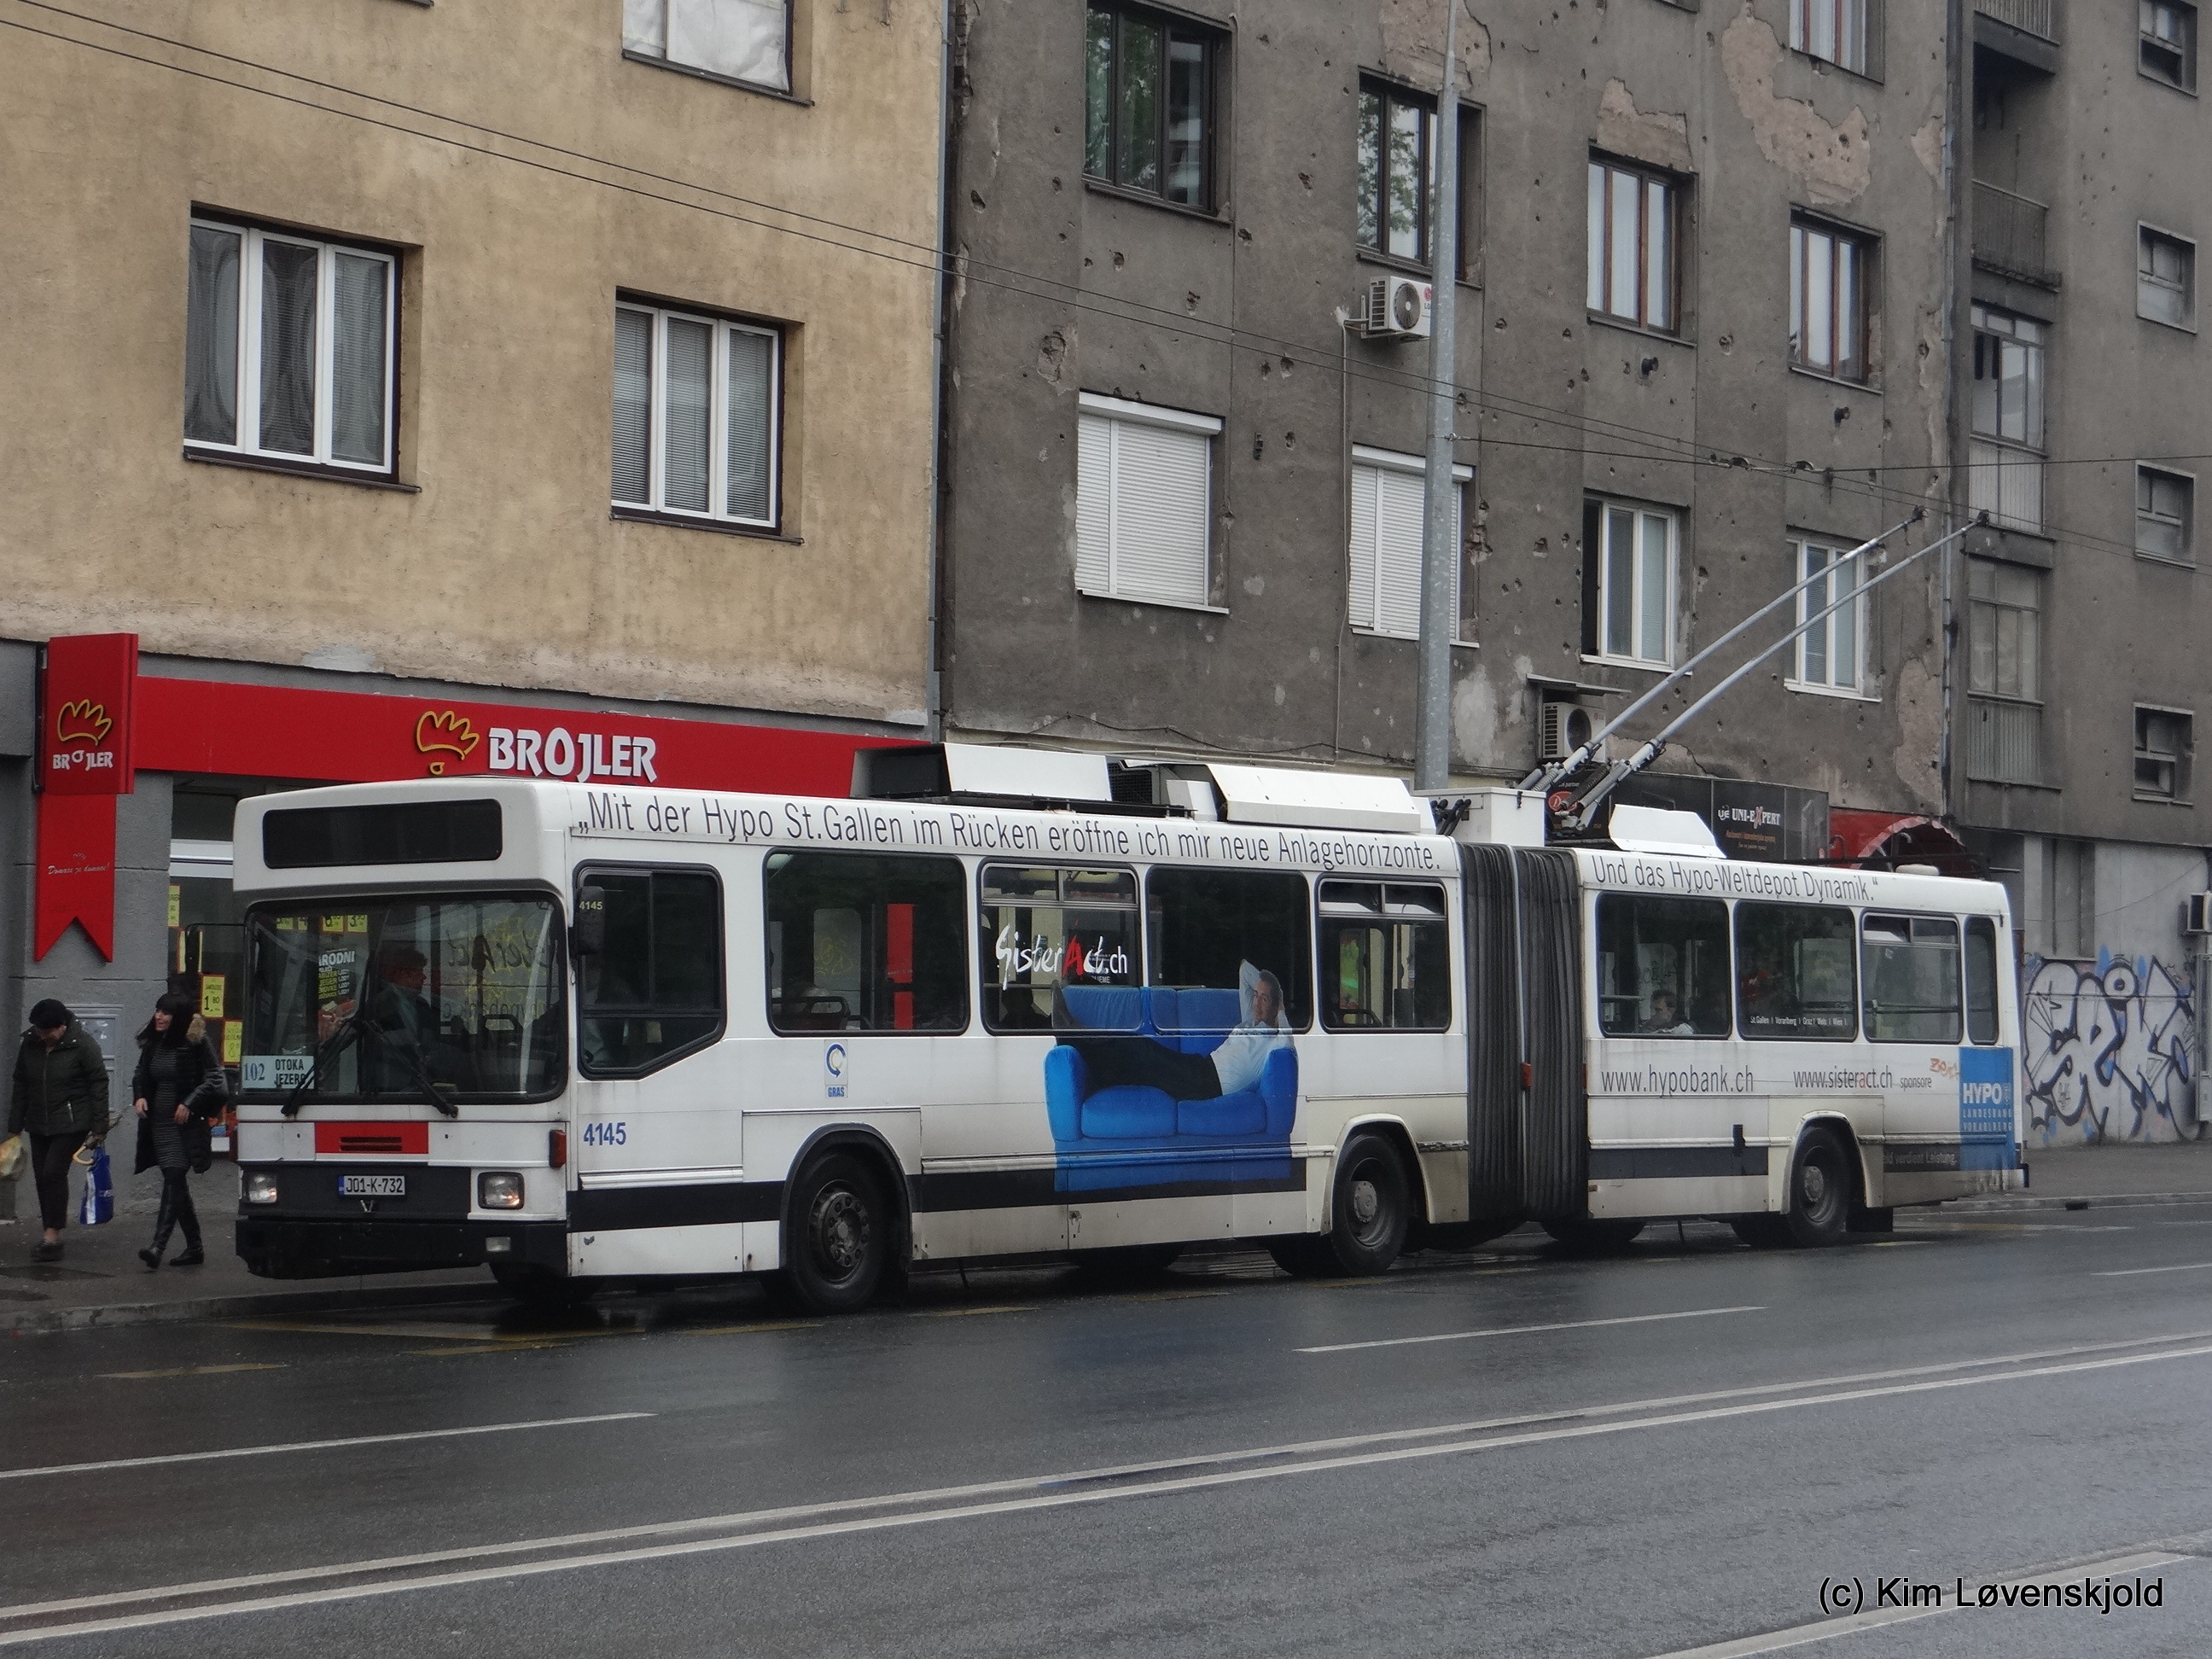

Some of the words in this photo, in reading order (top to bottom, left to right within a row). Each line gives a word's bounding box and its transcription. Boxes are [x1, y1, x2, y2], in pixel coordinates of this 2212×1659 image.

[52, 750, 114, 771] BROJLER
[488, 727, 658, 783] BROJLER
[1732, 806, 1781, 829] UNI-EXPERT
[646, 795, 691, 833] der
[701, 797, 773, 842] Hypo
[784, 802, 904, 843] St.Gallen
[911, 810, 943, 846] im
[950, 812, 1039, 850] Rücken
[1049, 820, 1129, 854] eröffne
[1136, 823, 1169, 856] ich
[1179, 827, 1210, 859] mir
[1220, 835, 1270, 862] neue
[1278, 831, 1441, 870] Anlagehorizonte.
[1592, 855, 1627, 885] Und
[1634, 859, 1665, 888] das
[1668, 860, 1800, 899] Hypo-Weltdepot
[579, 901, 602, 911] 4145
[244, 1062, 265, 1081] 102
[275, 1058, 304, 1070] OTOKA
[1601, 1064, 1754, 1098] www.hypobank.ch
[1793, 1065, 1893, 1089] www.sisteract.ch
[828, 1086, 845, 1097] GRAS
[1963, 1082, 2002, 1104] HYPO
[583, 1121, 626, 1146] 4145
[346, 1178, 403, 1193] J01-K-732
